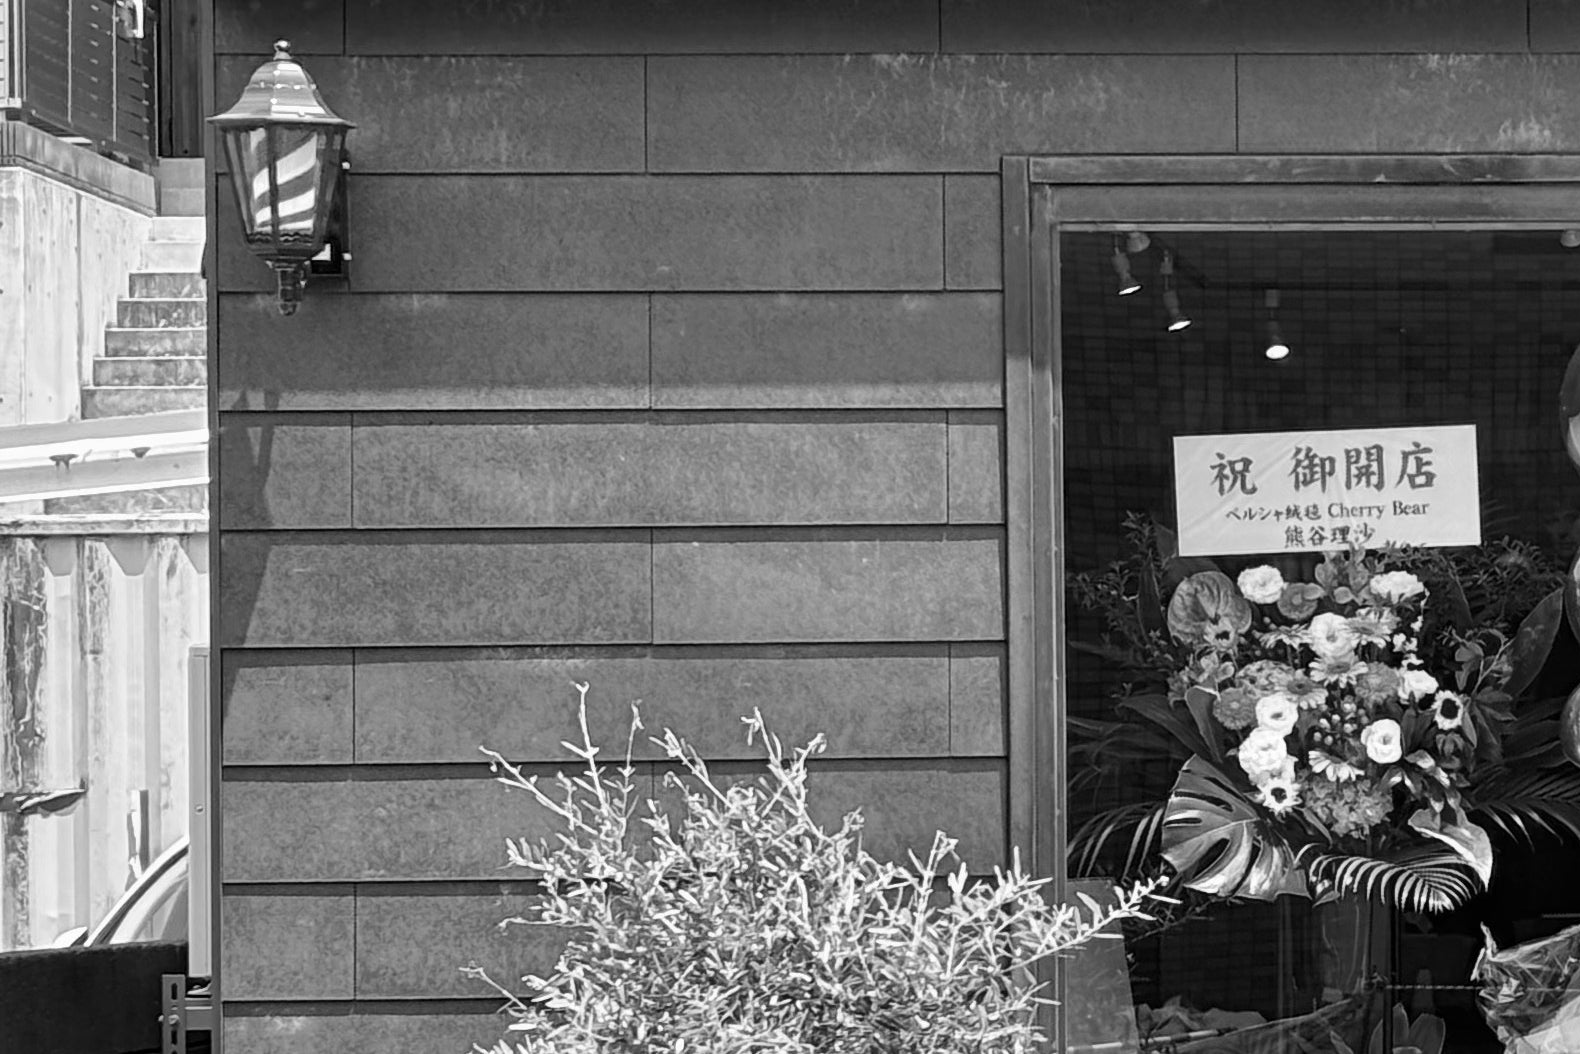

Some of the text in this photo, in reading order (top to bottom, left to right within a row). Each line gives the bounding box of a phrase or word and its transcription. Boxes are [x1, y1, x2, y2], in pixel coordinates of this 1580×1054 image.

[1209, 441, 1438, 496] 祝 御開店
[1327, 501, 1385, 520] Cherry
[1392, 499, 1430, 516] Bear
[1284, 522, 1376, 549] 熊谷理沙
